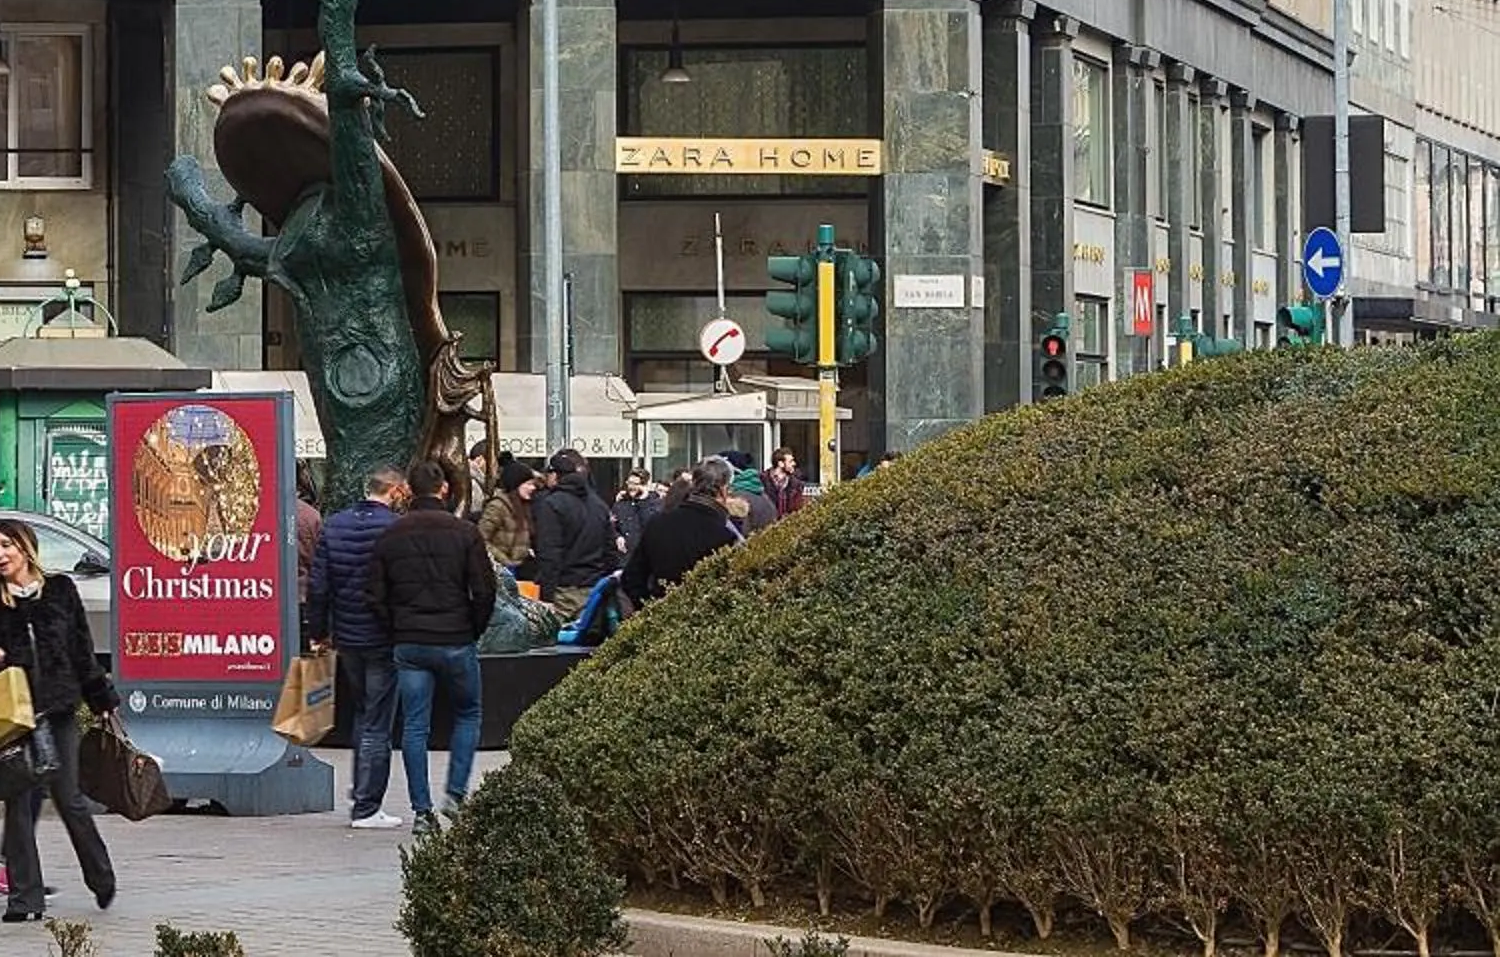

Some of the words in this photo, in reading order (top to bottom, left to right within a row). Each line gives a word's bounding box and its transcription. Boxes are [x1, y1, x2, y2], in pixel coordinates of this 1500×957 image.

[620, 146, 735, 167] ZARA
[759, 147, 876, 168] HOME
[1135, 286, 1151, 322] M
[591, 437, 604, 453] &
[122, 566, 273, 600] Christmas
[152, 695, 207, 711] Comune
[211, 694, 223, 710] di
[227, 694, 273, 711] Milano
